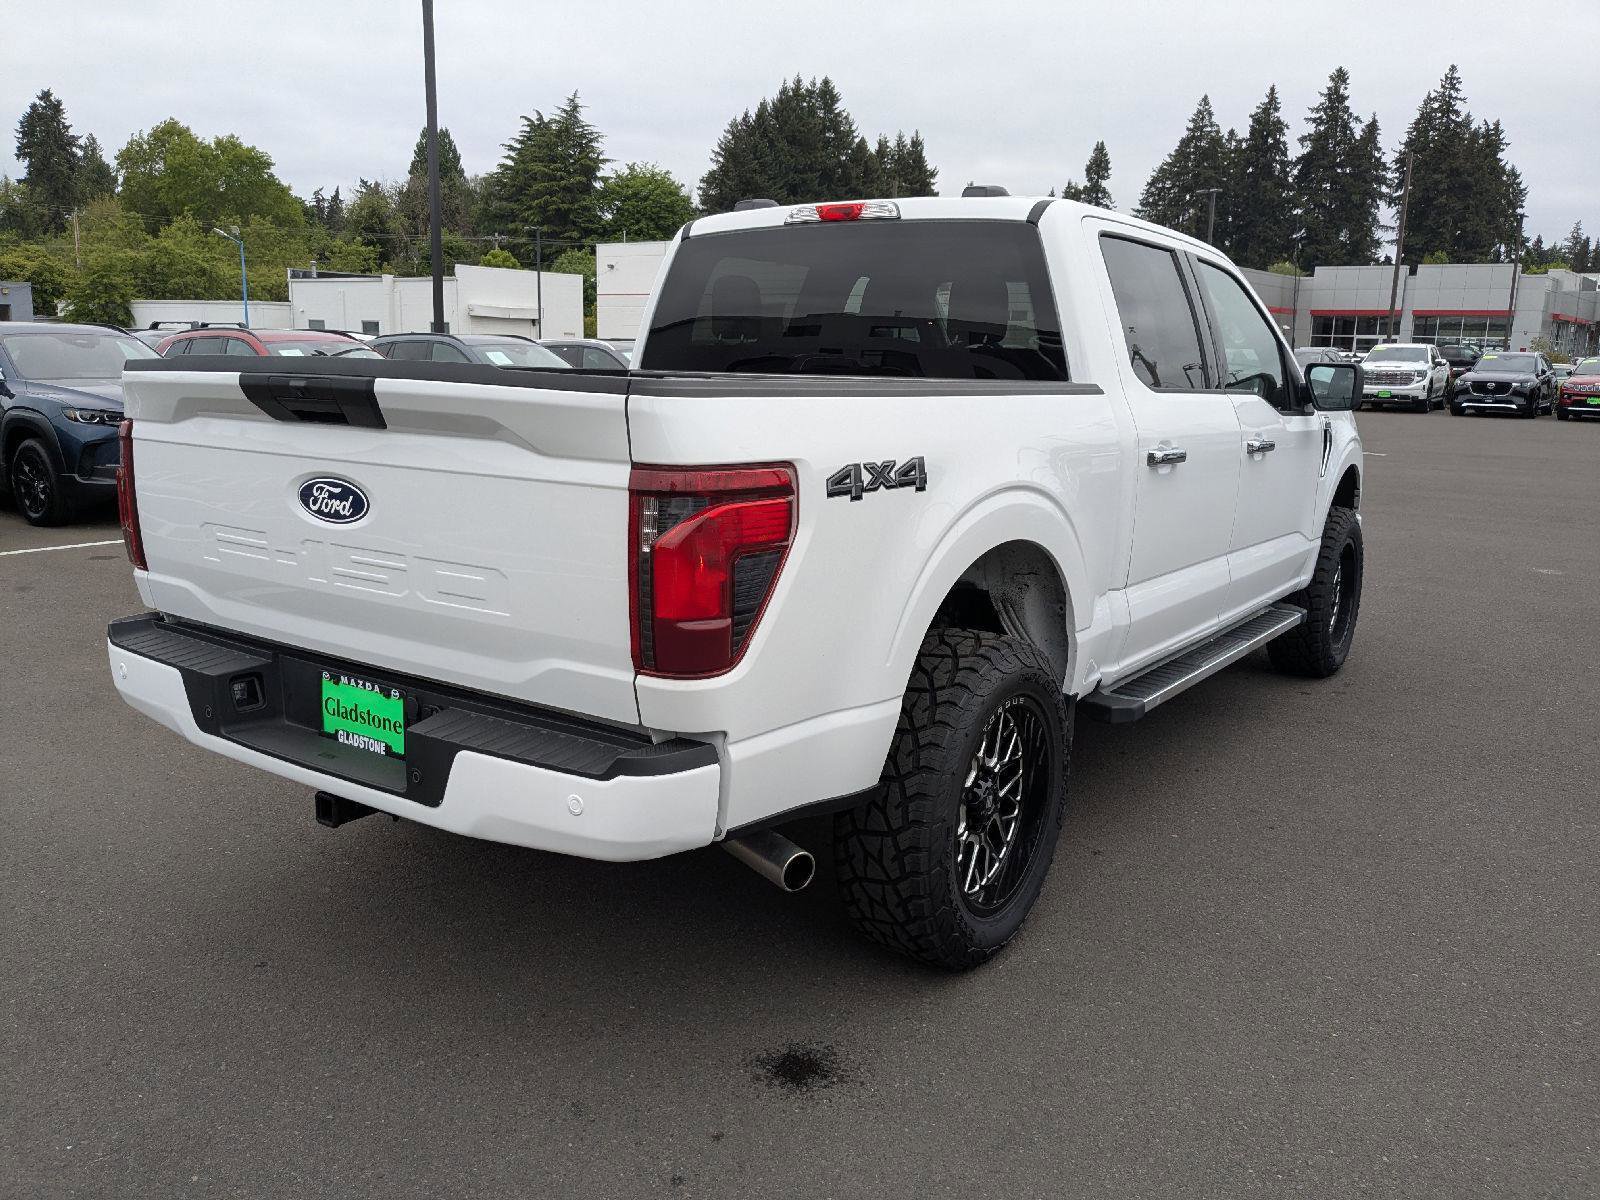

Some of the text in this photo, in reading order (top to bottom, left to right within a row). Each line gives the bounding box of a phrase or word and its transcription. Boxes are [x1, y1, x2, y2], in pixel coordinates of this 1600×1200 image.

[310, 483, 353, 516] Ford
[340, 675, 381, 694] MAZDA
[324, 697, 403, 735] Gladstone
[337, 730, 386, 755] GLADSTONE
